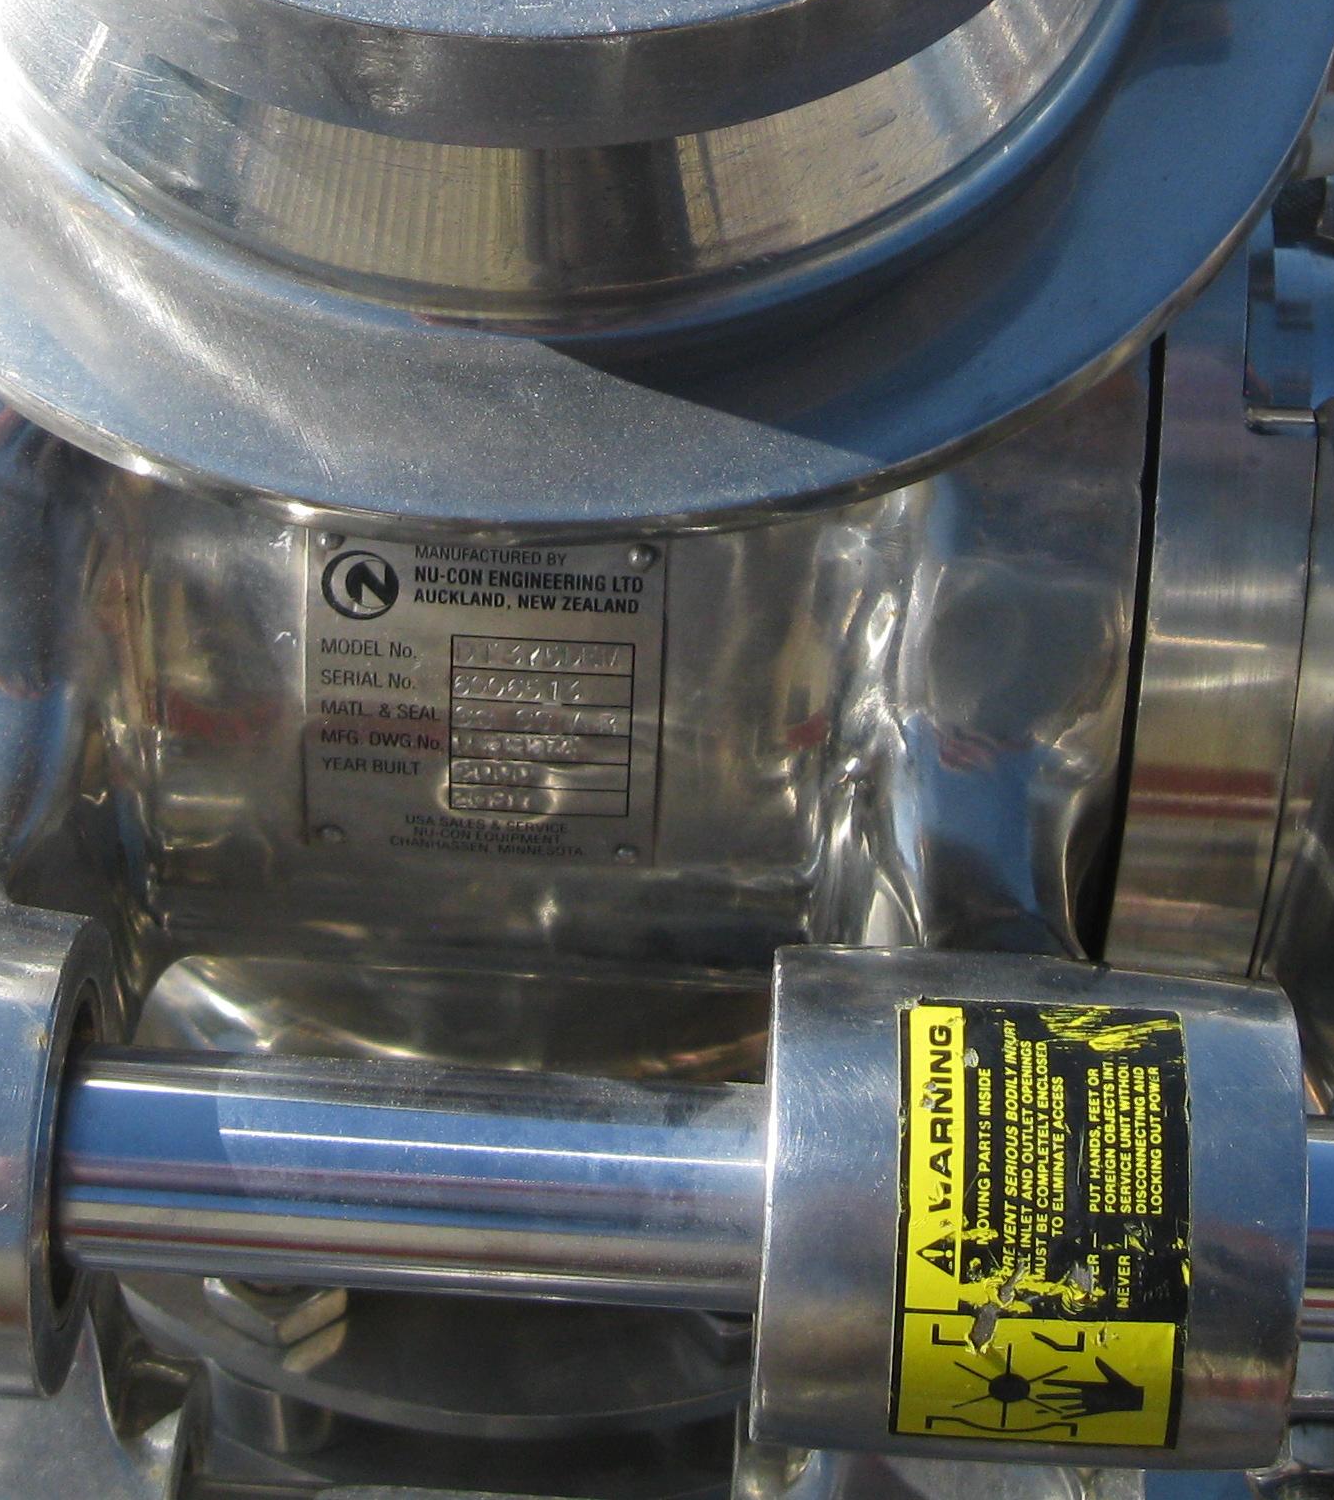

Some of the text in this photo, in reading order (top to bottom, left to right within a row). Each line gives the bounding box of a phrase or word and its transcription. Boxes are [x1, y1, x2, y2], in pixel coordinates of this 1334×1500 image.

[415, 545, 567, 567] MANUFACTURED BY
[415, 566, 644, 594] NU-CON ENGINEERING LTD
[414, 587, 640, 615] AUCKLAND, NEW ZEALAND
[320, 637, 383, 657] MODEL
[320, 668, 383, 688] SERIAL
[378, 702, 391, 718] &
[396, 703, 441, 722] SEAL
[322, 757, 420, 775] YEAR BUILT
[1002, 1018, 1018, 1066] INJURY
[1003, 1067, 1019, 1122] BODILY
[1020, 1040, 1033, 1104] OPENINGS
[1087, 1067, 1099, 1087] OR
[1088, 1088, 1101, 1122] FEET
[1021, 1108, 1034, 1164] OUTLET
[1088, 1125, 1102, 1180] HANDS,
[1102, 1056, 1117, 1213] FOREIGN OBJECTS INT
[1119, 1115, 1132, 1148] UNIT
[1132, 1066, 1147, 1215] DISCONNECTING AND
[1147, 1066, 1163, 1215] LOCKING OUT POWER
[976, 1068, 992, 1245] MOVING PARTS INSIDE
[1004, 1125, 1019, 1198] SERIOUS
[1034, 1041, 1049, 1281] MUST BE COMPLETELY ENCLOSED
[1051, 1076, 1065, 1238] TO ELIMINATE ACCESS
[1021, 1168, 1034, 1201] AND
[1089, 1183, 1101, 1213] PUT
[1120, 1152, 1132, 1214] SERVICE
[1020, 1205, 1033, 1249] INLET
[1116, 1255, 1131, 1309] NEVER
